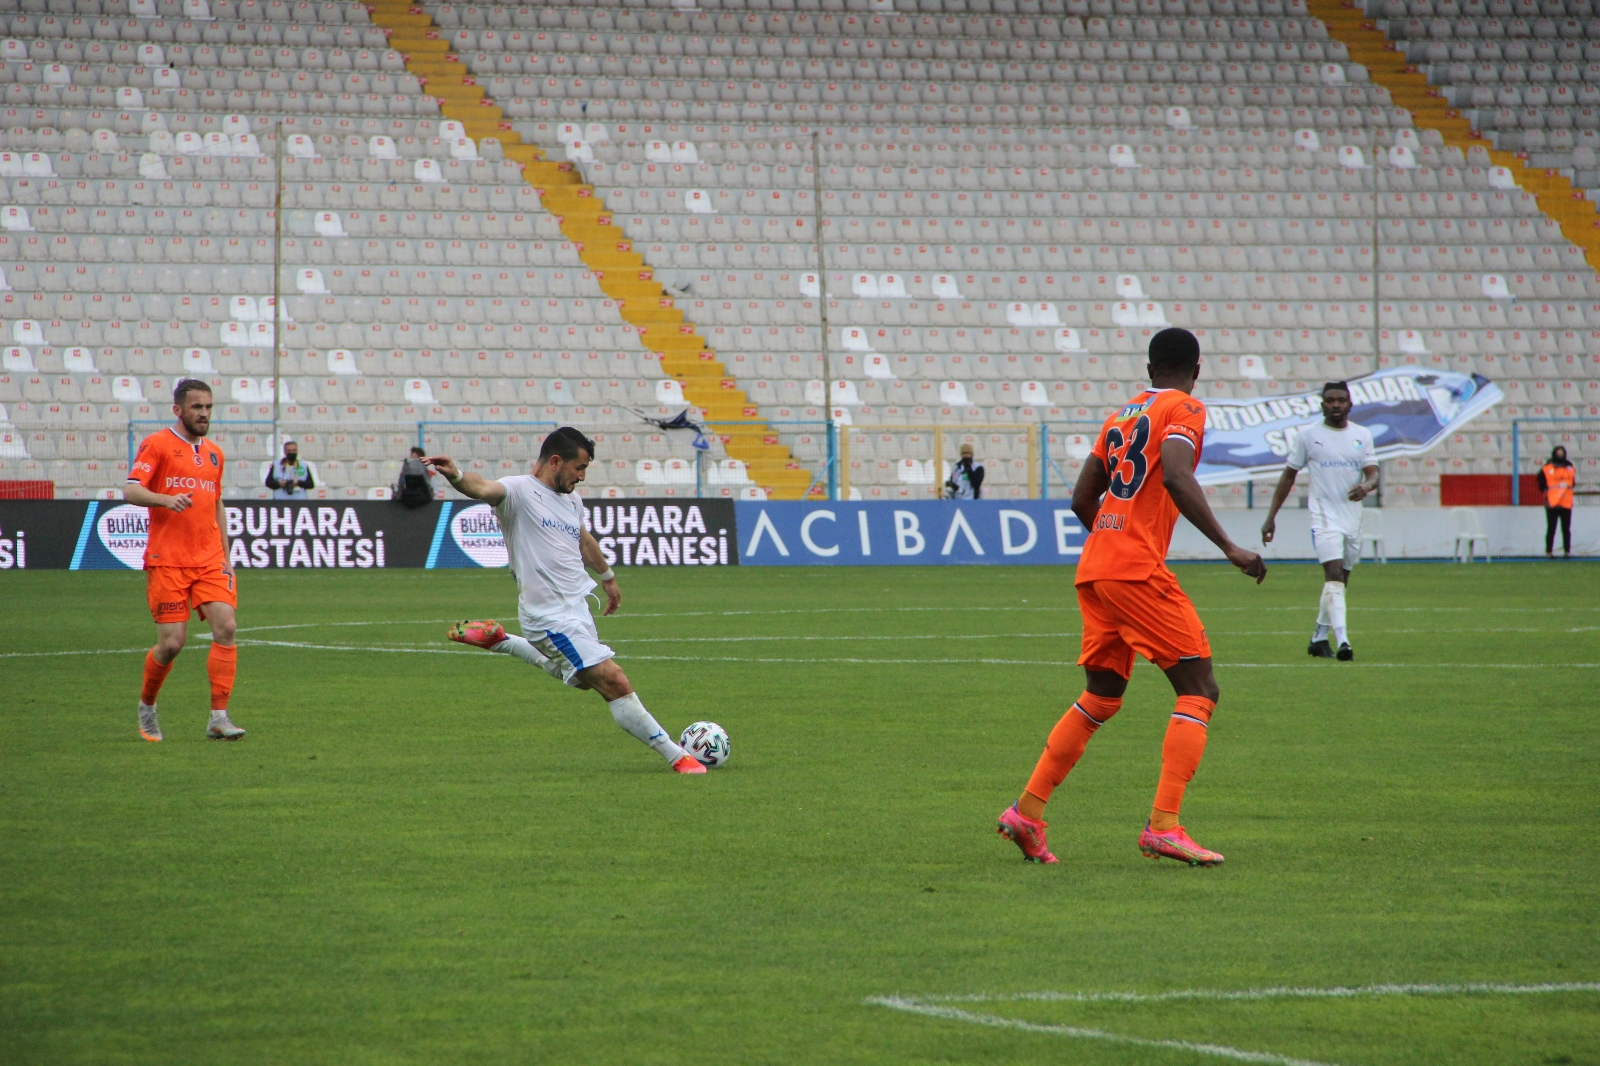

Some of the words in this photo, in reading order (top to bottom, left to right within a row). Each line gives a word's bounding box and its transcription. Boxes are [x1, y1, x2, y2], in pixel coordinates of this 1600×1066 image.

[1347, 375, 1421, 407] ADAR
[1105, 414, 1151, 500] 63
[165, 476, 197, 489] DECO
[224, 506, 363, 537] BUHARA
[746, 508, 1085, 558] ACIBADE
[229, 530, 386, 569] ASTANESİ
[598, 528, 729, 566] STANESİ
